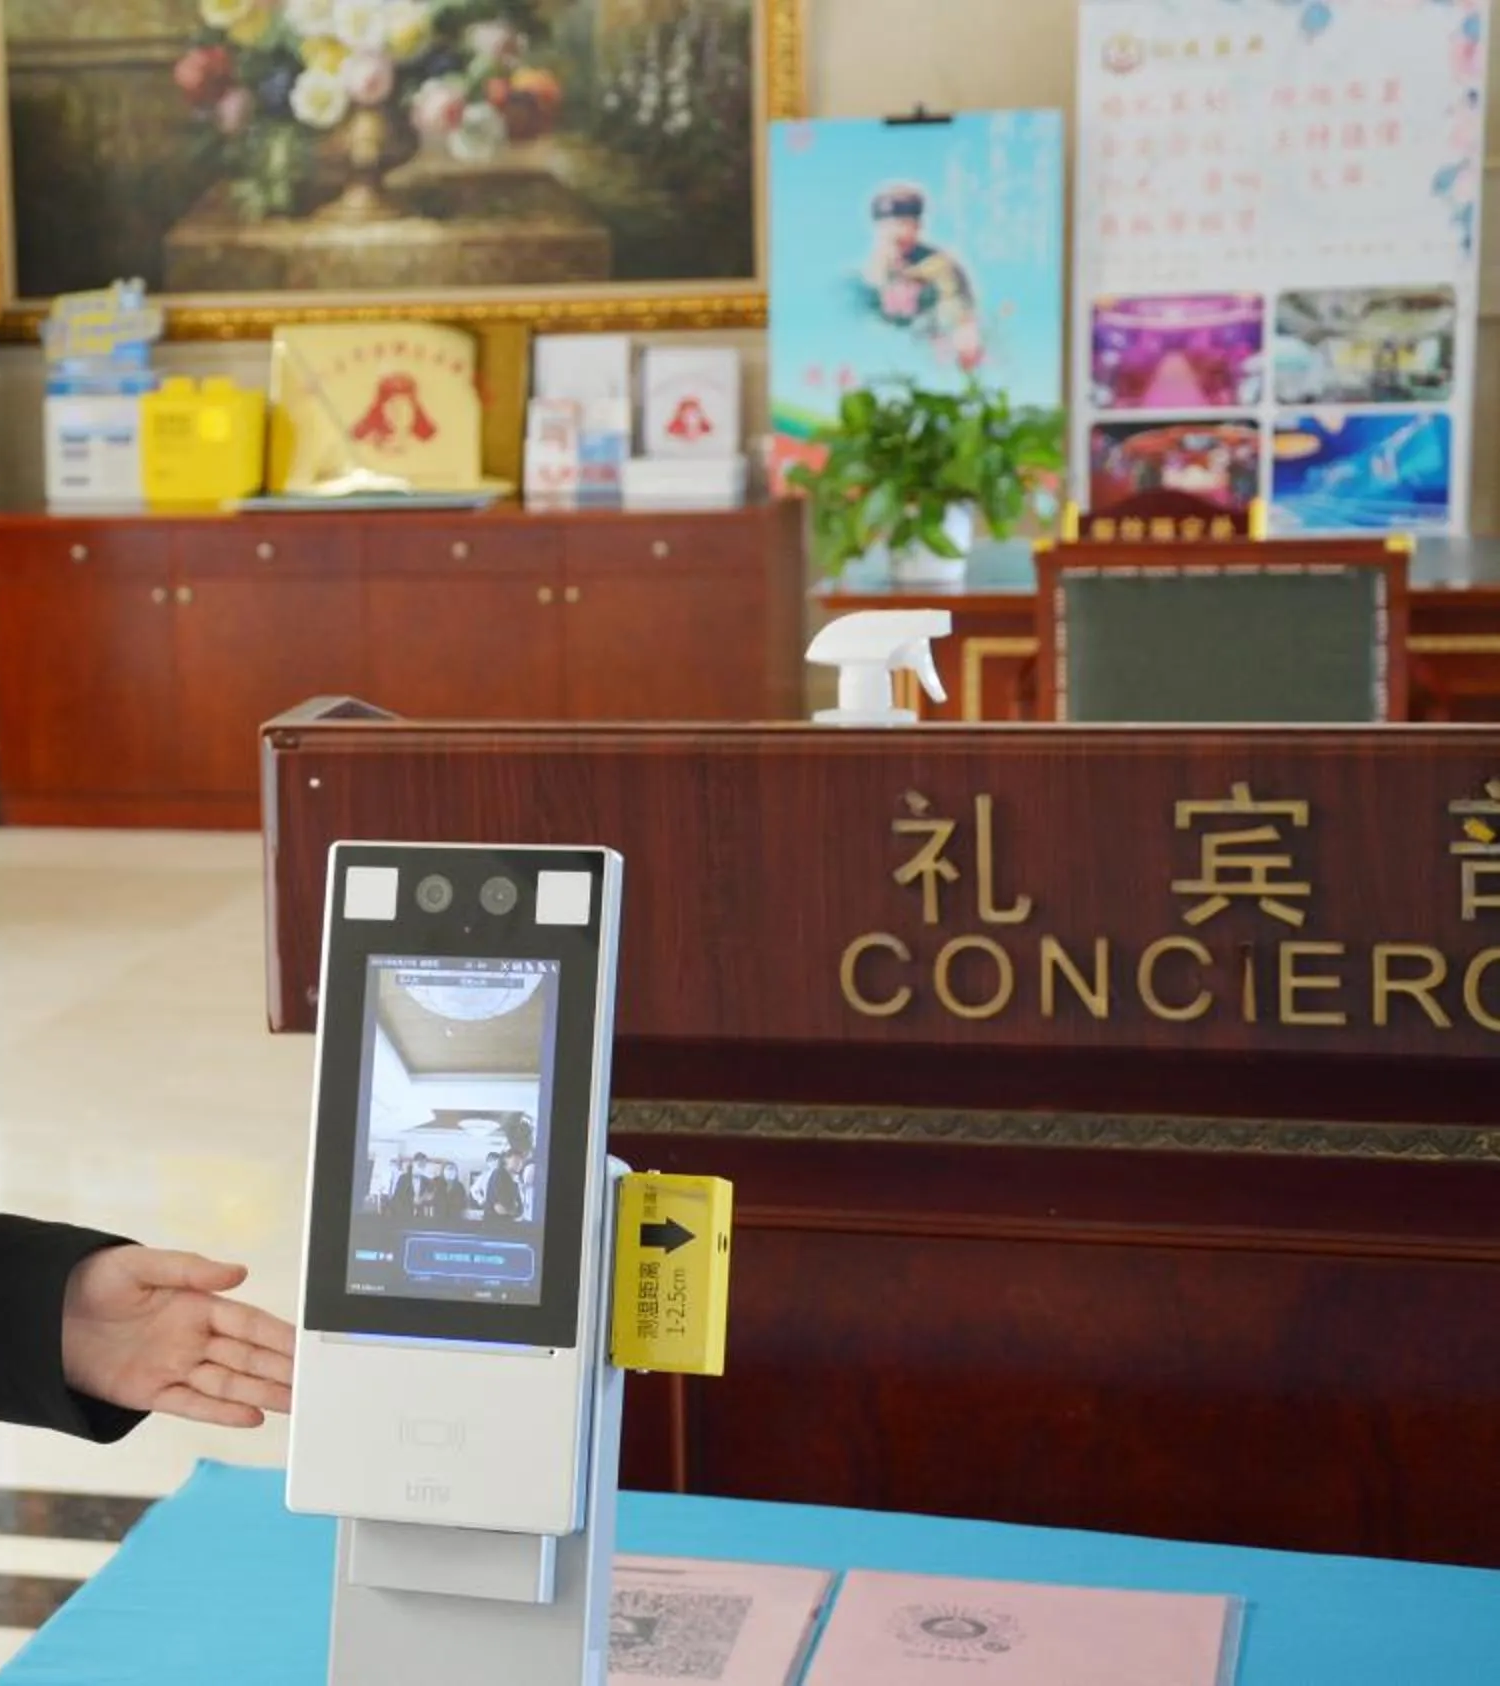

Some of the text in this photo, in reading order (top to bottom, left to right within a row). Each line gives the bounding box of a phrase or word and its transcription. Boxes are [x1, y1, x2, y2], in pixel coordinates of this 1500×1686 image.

[637, 1262, 660, 1339] 测温距离
[665, 1268, 687, 1338] 1-2.5cm
